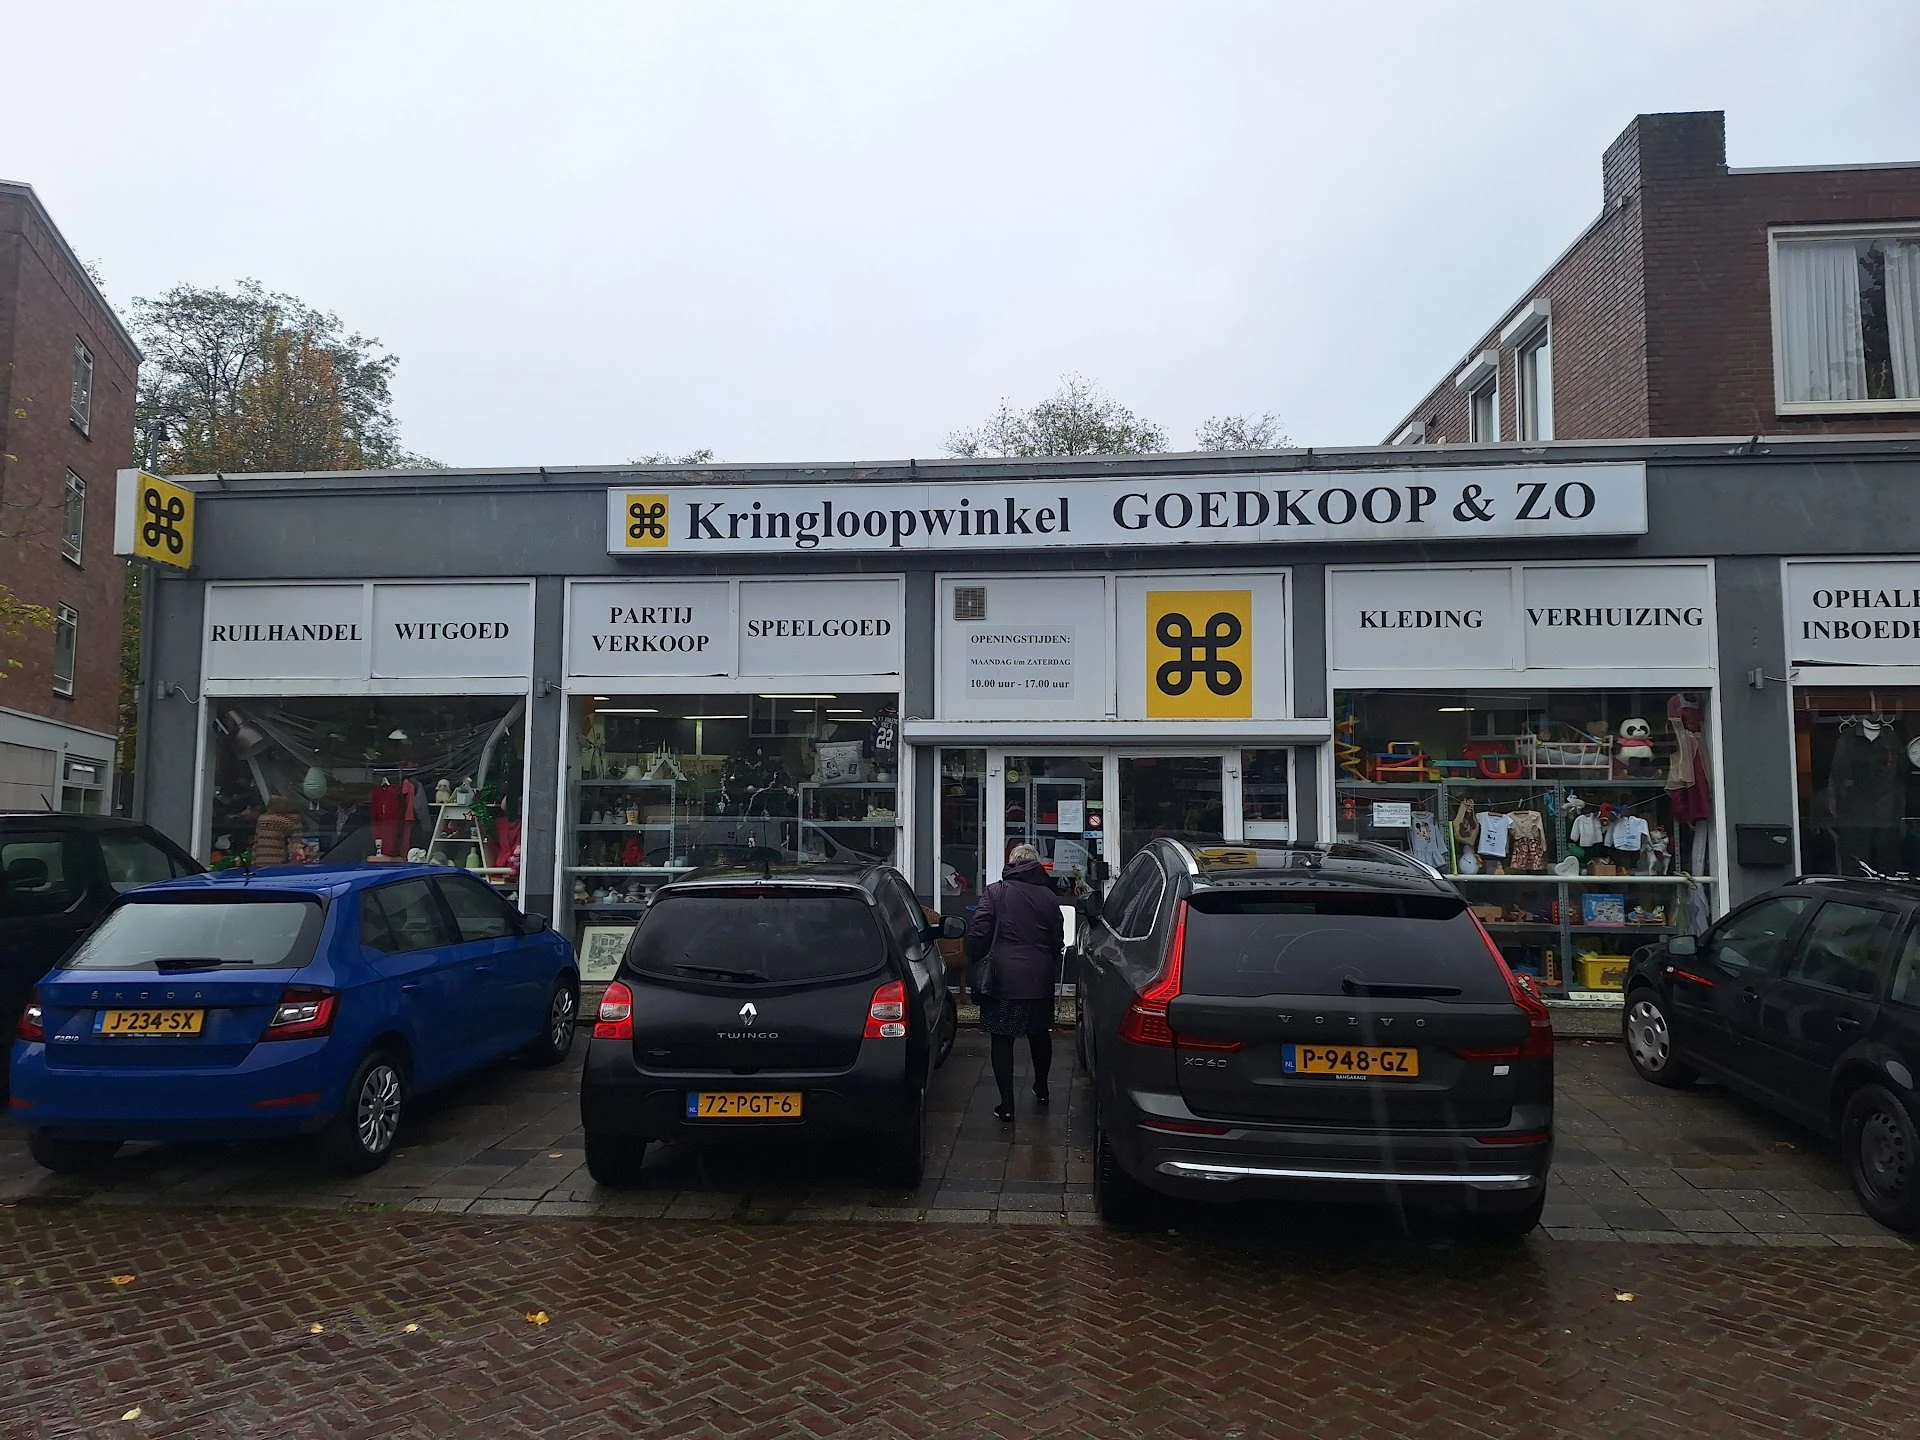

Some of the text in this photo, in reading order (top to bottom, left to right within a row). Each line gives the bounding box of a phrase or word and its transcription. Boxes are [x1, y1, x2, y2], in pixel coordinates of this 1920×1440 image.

[685, 481, 1597, 549] Kringloopwinkel GOEDKOOP & ZO
[609, 606, 694, 625] PARTIJ
[1359, 610, 1483, 628] KLEDING
[1527, 606, 1703, 627] VERHUIZING
[211, 623, 363, 643] RUILHANDEL
[395, 621, 510, 641] WITGOED
[747, 619, 891, 638] SPEELGOED
[592, 634, 710, 653] VERKOOP
[971, 635, 1071, 644] OPENINGSTIJDEN:
[971, 679, 996, 688] 10.00
[1025, 679, 1050, 688] 17.00
[876, 727, 893, 749] 22
[111, 1013, 195, 1030] J-234-SX
[1278, 1014, 1426, 1027] VOLVO
[1184, 1057, 1227, 1068] XC60
[1303, 1049, 1409, 1072] P-948-GZ
[705, 1095, 792, 1113] 72-PGT-6
